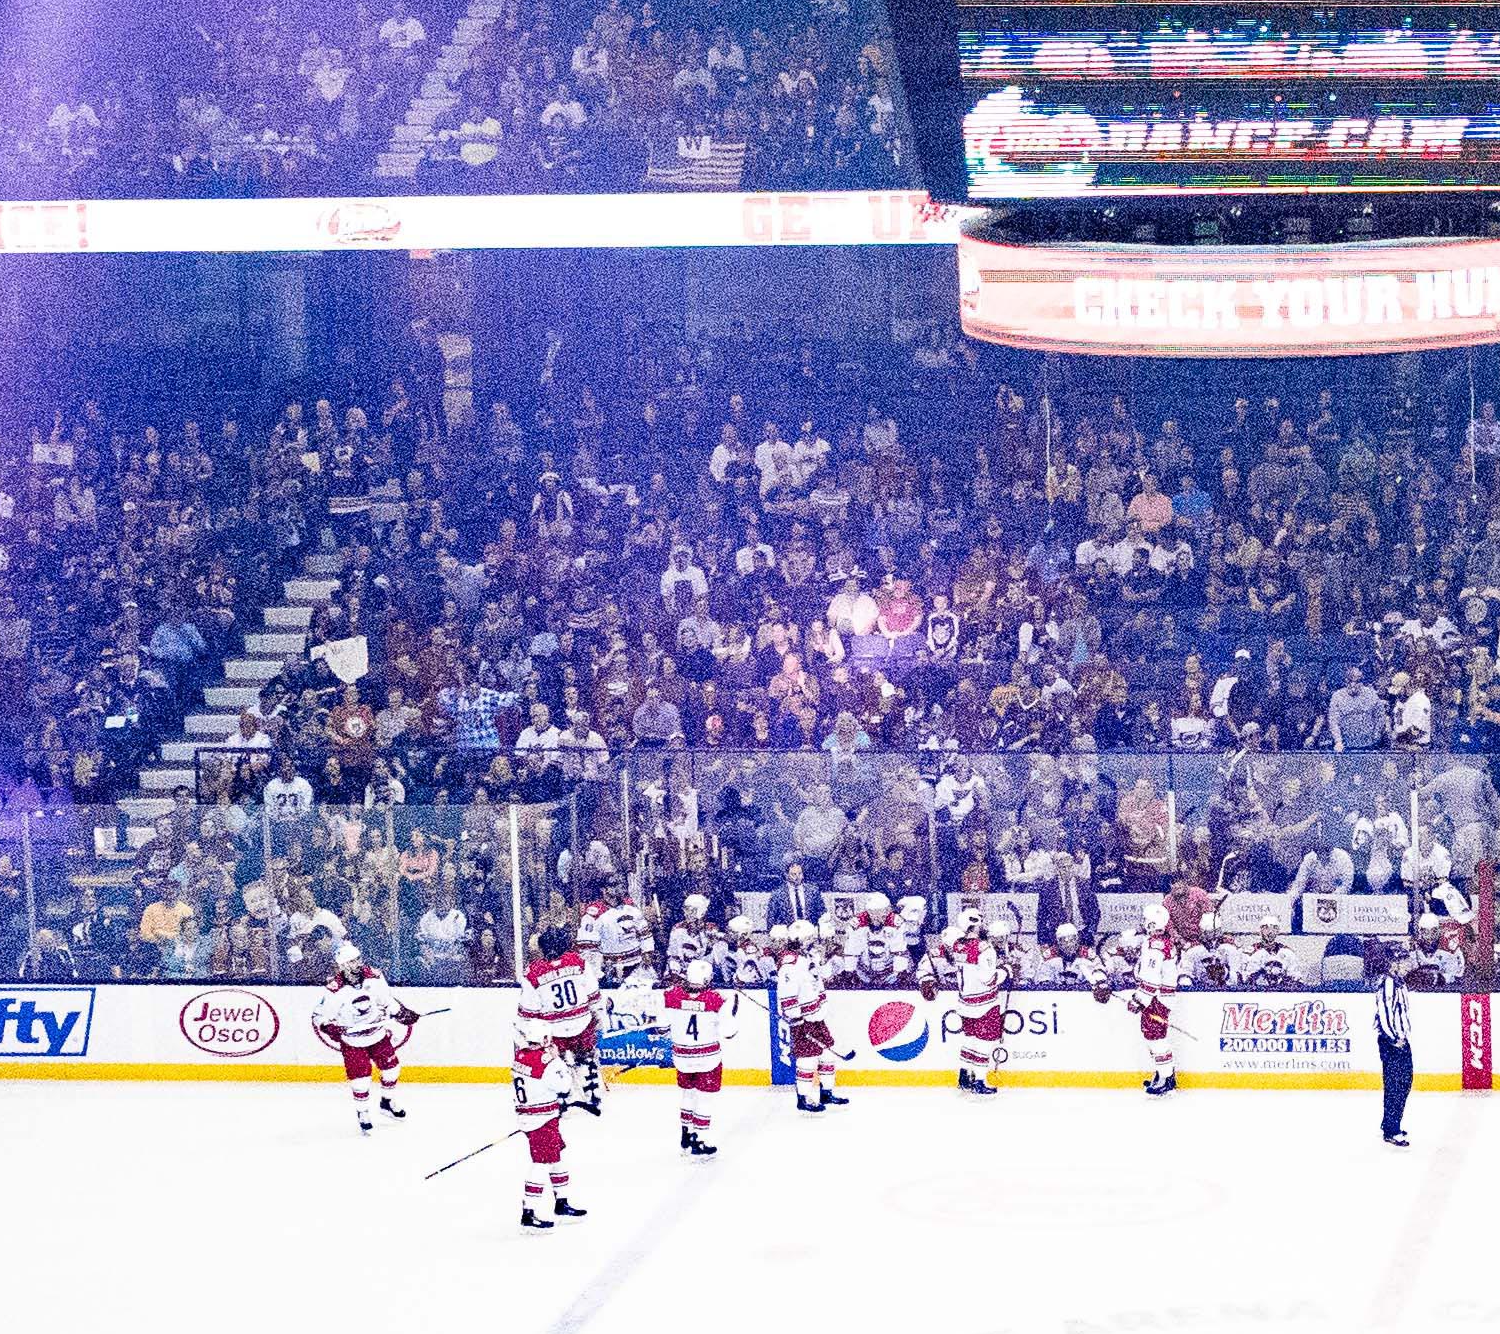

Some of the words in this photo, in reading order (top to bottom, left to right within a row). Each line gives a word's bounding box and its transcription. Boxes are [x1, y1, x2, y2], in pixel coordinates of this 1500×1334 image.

[1326, 117, 1472, 151] CAM
[1071, 274, 1240, 327] CHECK
[1252, 274, 1403, 327] YOUR
[551, 979, 578, 1009] 30
[192, 999, 263, 1026] Jewel
[686, 1013, 700, 1041] 4
[941, 1002, 1060, 1043] ppsi
[1221, 1002, 1350, 1035] Merlin
[195, 1022, 261, 1045] Osco
[1291, 1038, 1352, 1054] MILES
[1469, 999, 1484, 1070] CCM
